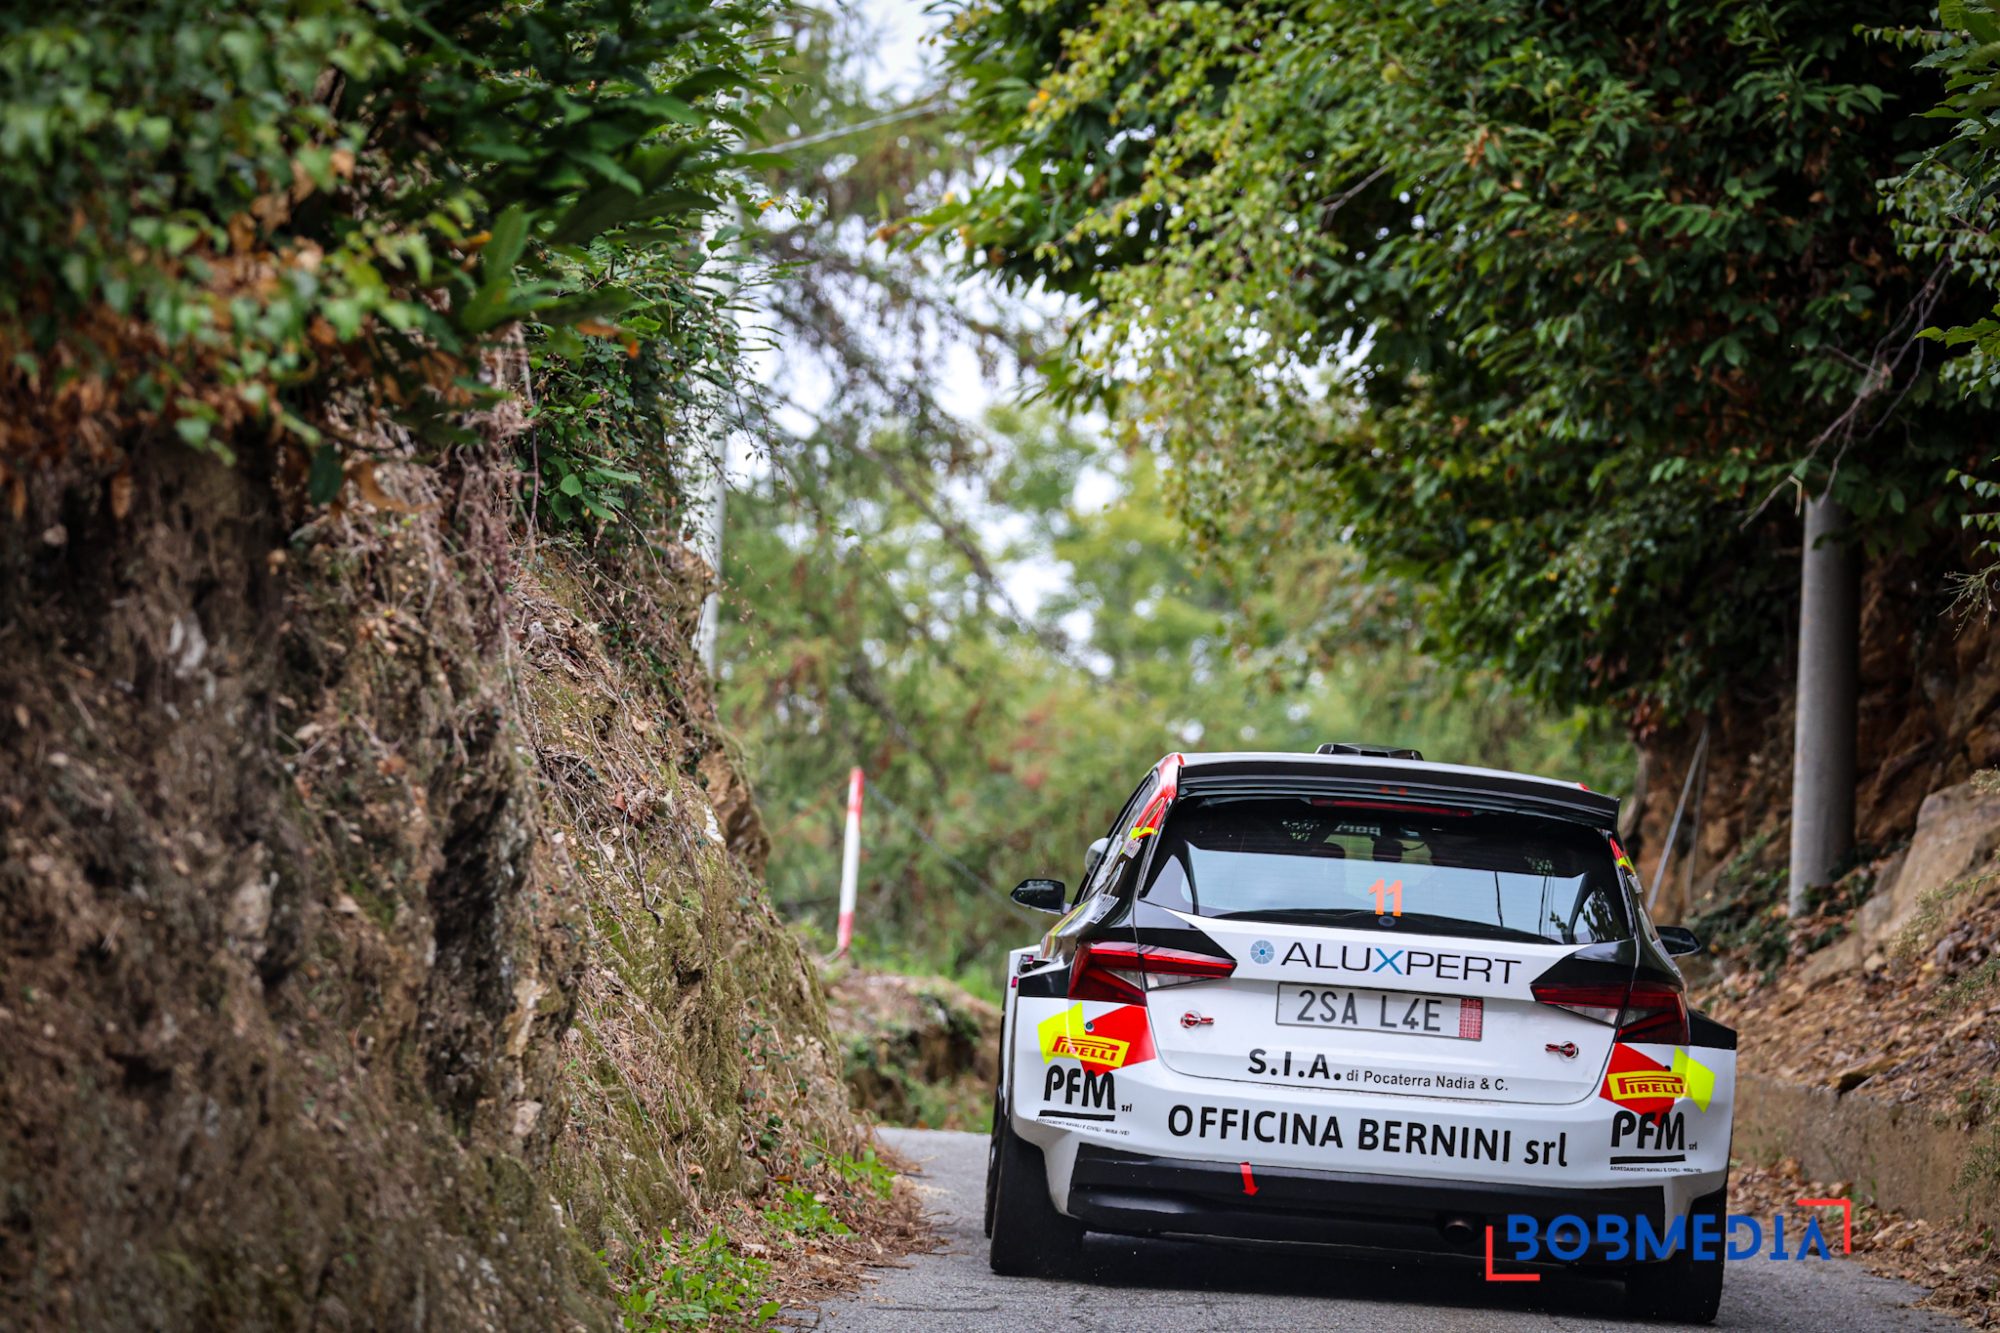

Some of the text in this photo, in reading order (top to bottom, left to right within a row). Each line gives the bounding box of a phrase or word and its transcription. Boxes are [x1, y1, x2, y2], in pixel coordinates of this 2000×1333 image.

[1368, 879, 1402, 917] 11
[1280, 942, 1522, 984] ALUXPERT
[1297, 989, 1358, 1025] 2SA
[1380, 995, 1442, 1032] L4E
[1052, 1035, 1120, 1062] PIRELLI
[1247, 1048, 1509, 1091] S.I.A. di Pocaterra Nadia & C.
[1044, 1065, 1133, 1113] PFM srl
[1617, 1075, 1686, 1095] PIRELLI
[1168, 1104, 1568, 1167] OFFICINA BERNINI srl
[1611, 1110, 1698, 1150] PFM srl
